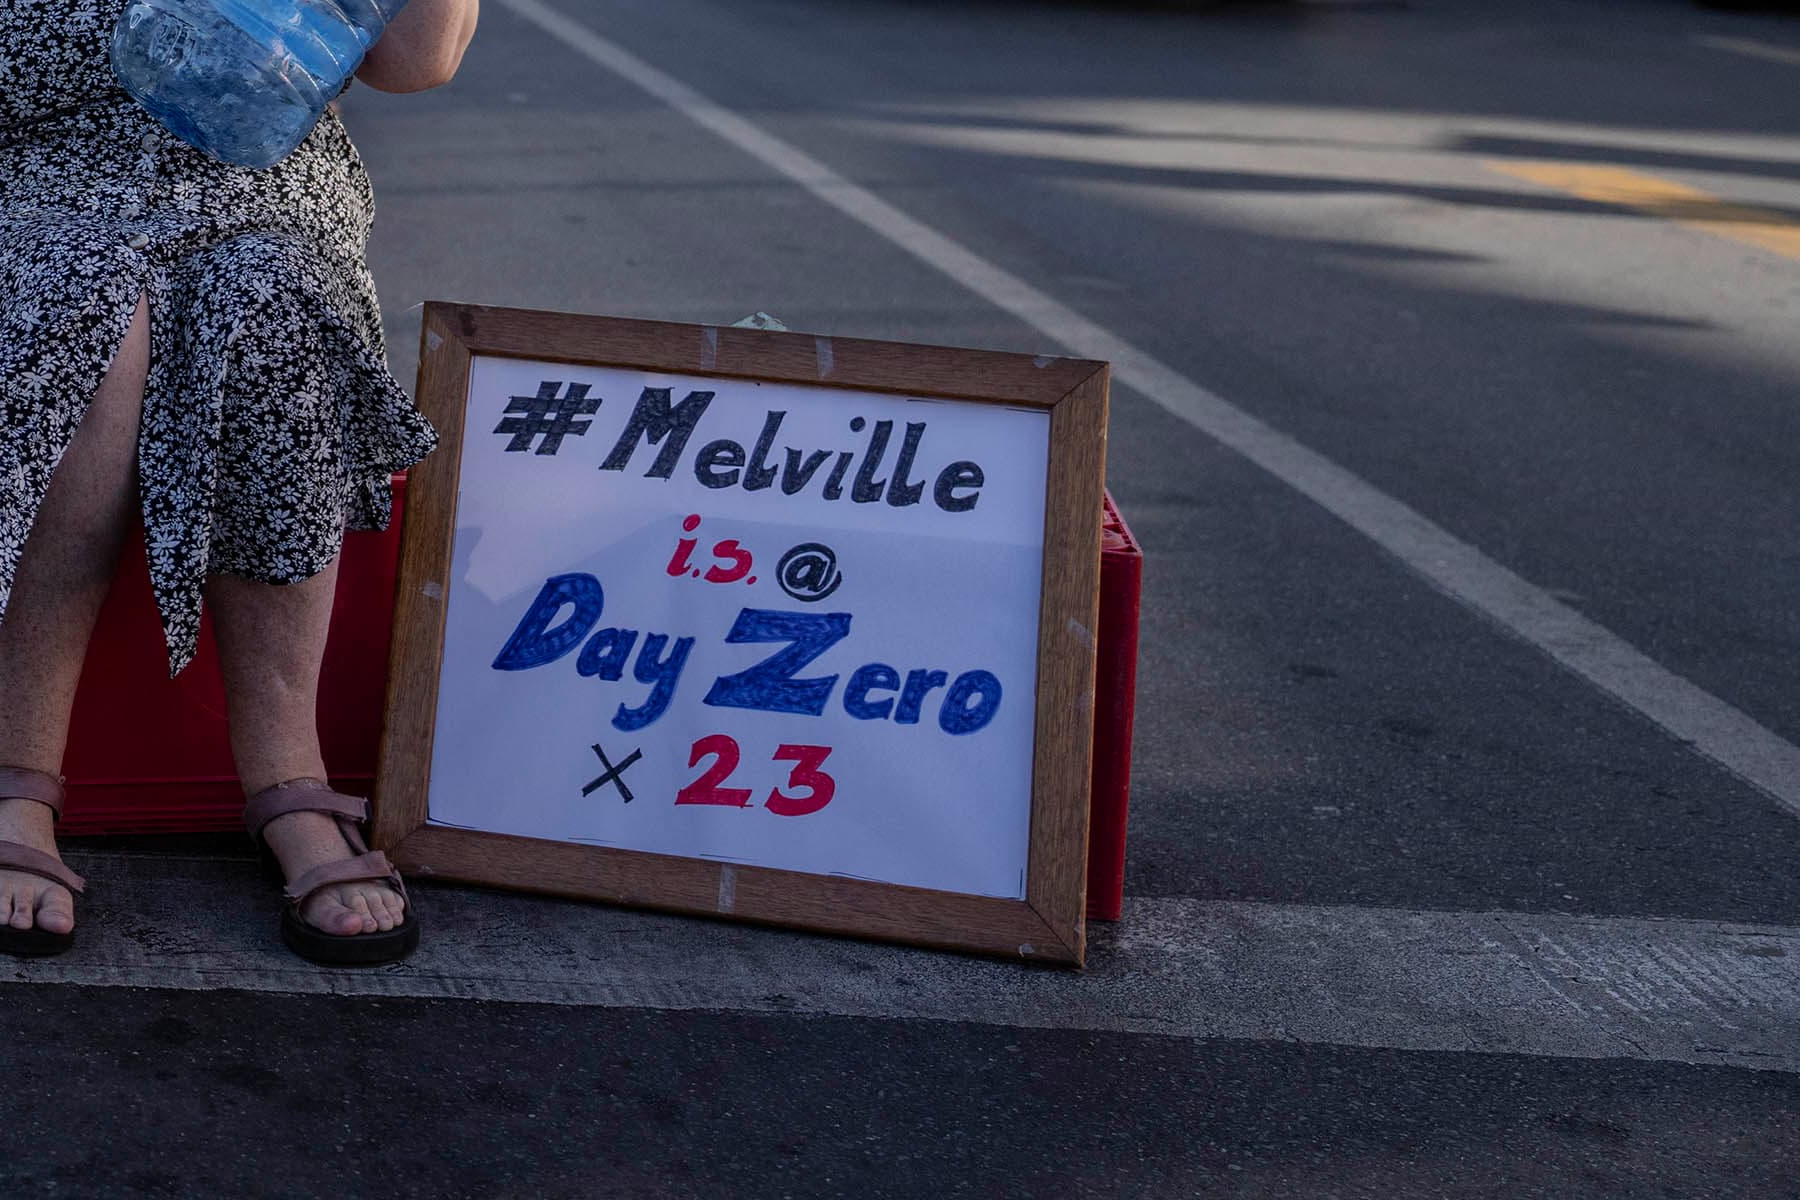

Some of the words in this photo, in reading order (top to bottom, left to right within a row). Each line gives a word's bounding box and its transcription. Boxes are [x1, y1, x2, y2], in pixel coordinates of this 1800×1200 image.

[774, 541, 843, 603] @
[492, 572, 695, 733] Day
[702, 607, 1004, 737] Zero
[673, 733, 837, 817] 23
